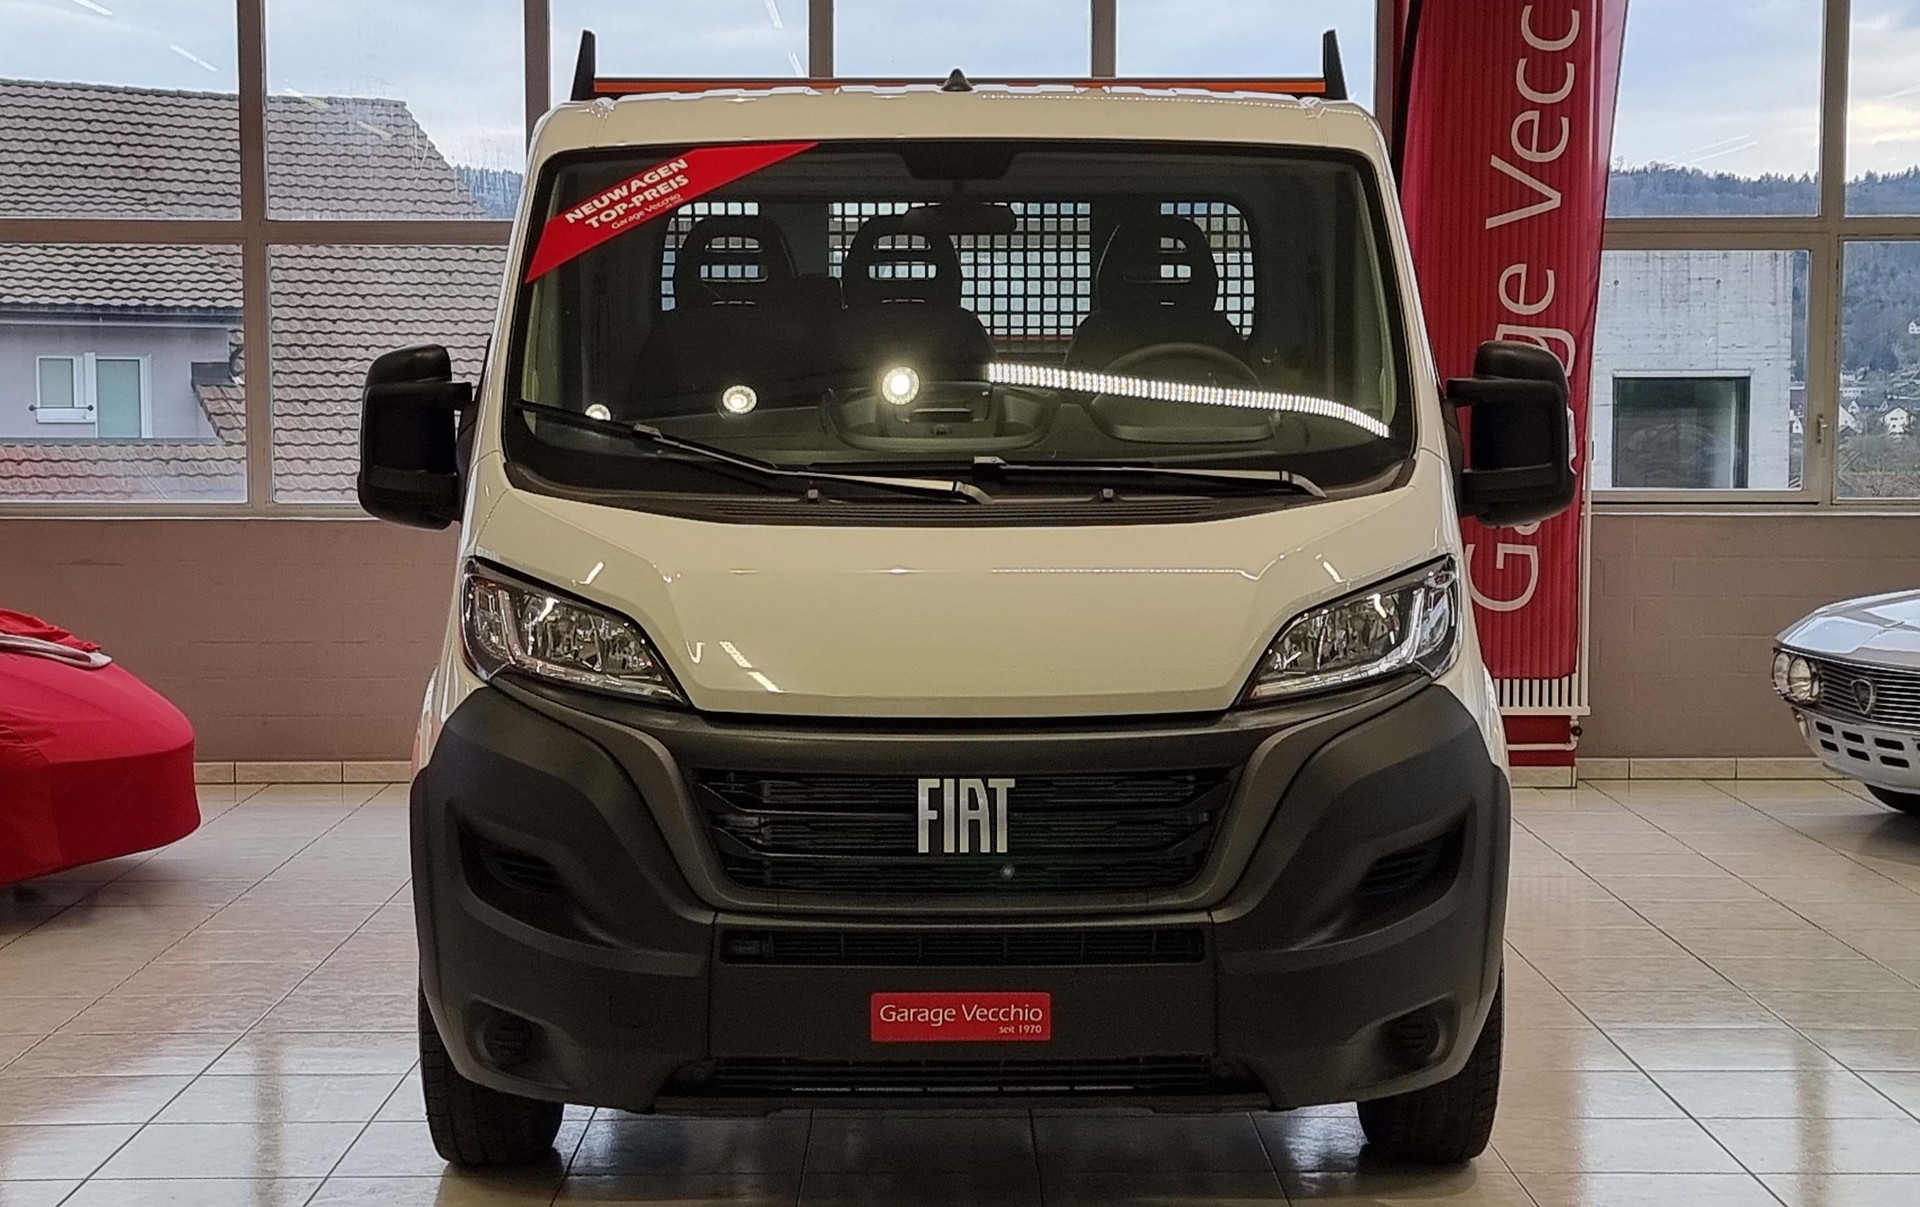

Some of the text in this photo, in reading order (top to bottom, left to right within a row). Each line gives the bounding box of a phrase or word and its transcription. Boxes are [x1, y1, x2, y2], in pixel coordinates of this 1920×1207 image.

[565, 159, 688, 223] NEUWAGEN
[585, 175, 689, 228] TOP-PREIS
[611, 211, 645, 229] Garage
[644, 193, 682, 213] Vecchio
[917, 778, 1016, 854] FIAT
[879, 1003, 1044, 1027] Garage Vecchio
[998, 1024, 1043, 1034] seit 1970
